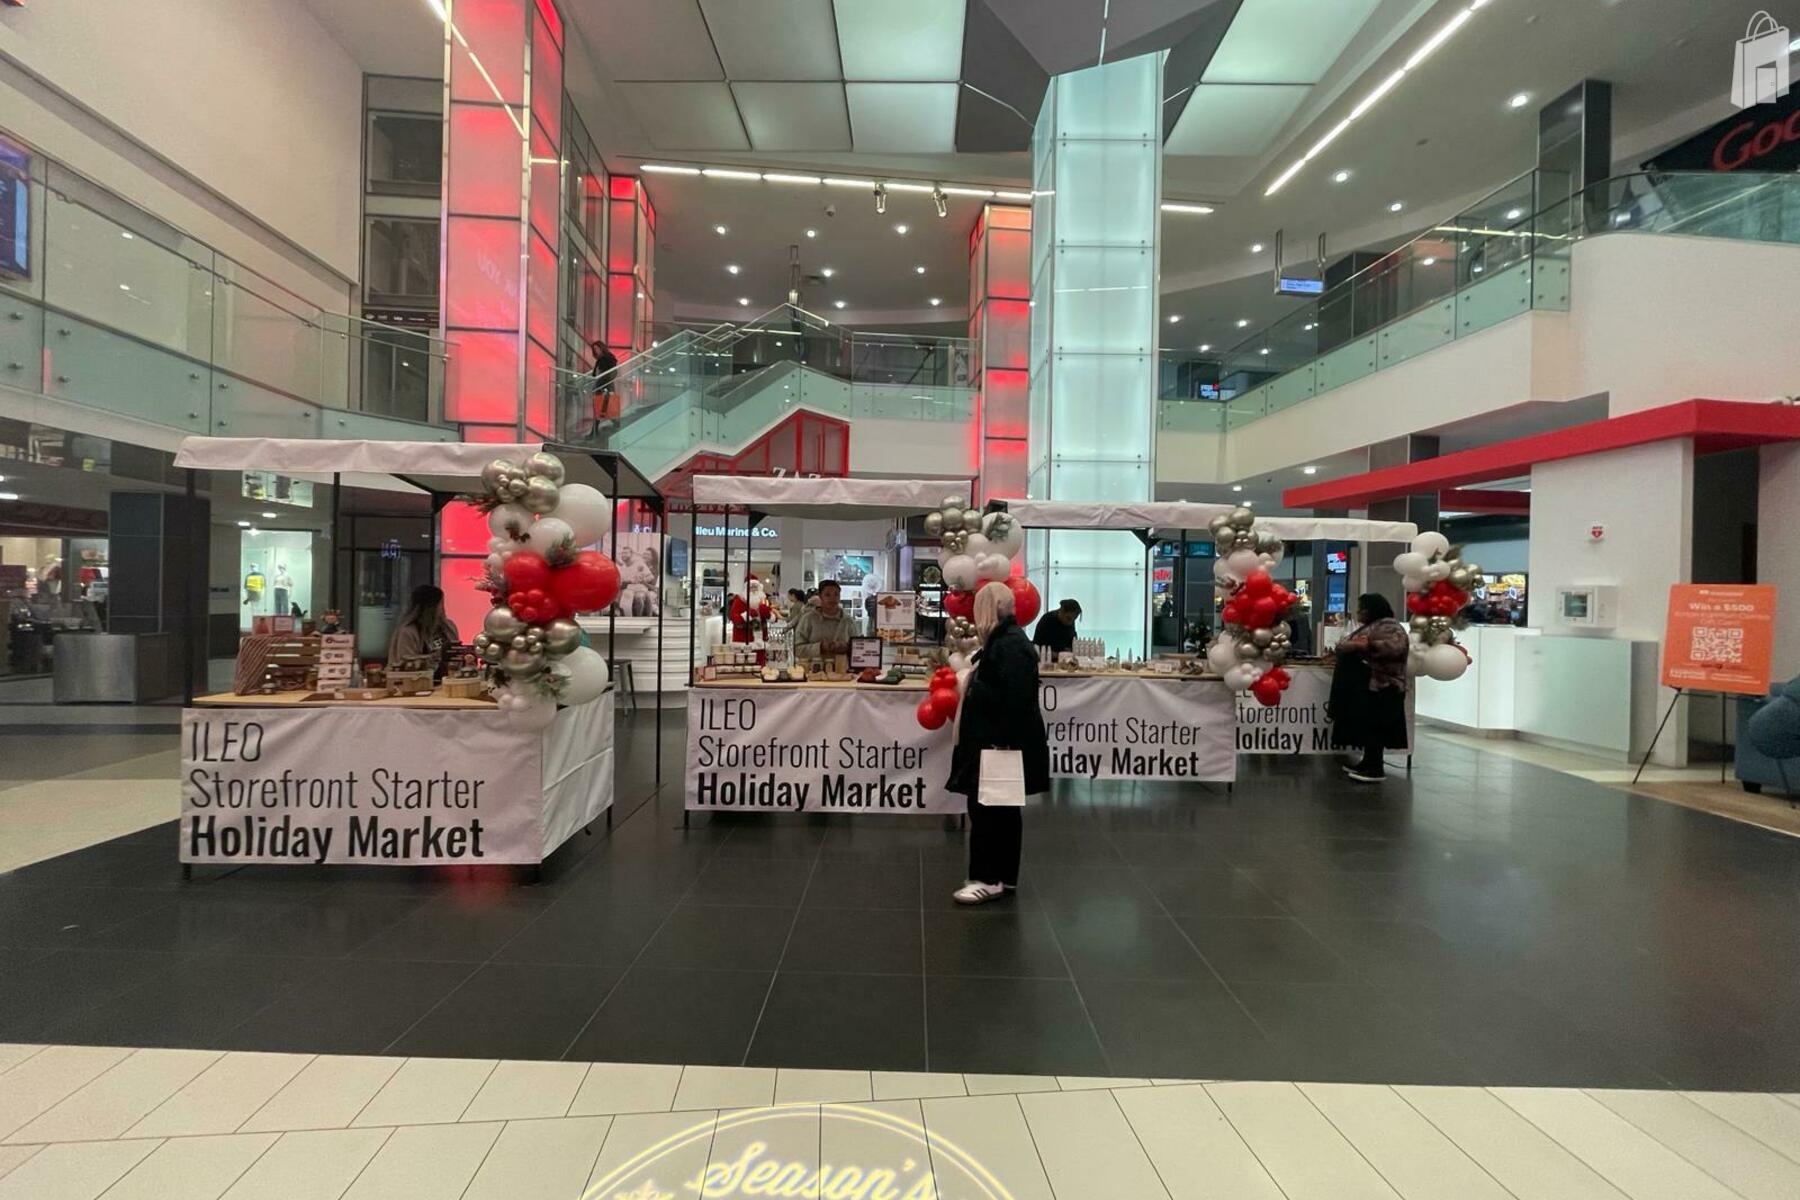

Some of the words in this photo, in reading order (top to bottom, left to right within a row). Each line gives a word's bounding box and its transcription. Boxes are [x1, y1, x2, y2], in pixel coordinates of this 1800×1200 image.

[752, 527, 760, 536] &
[761, 527, 778, 537] Co.
[700, 698, 757, 731] ILEO
[1235, 702, 1316, 724] torefront
[191, 721, 264, 762] ILEO
[1046, 716, 1118, 743] refront
[1125, 717, 1200, 745] Starter
[698, 735, 830, 769] Storefront
[838, 737, 927, 769] Starter
[1052, 746, 1102, 779] iday
[1111, 747, 1199, 777] Market
[189, 768, 358, 808] Storefront
[371, 768, 485, 809] Starter
[698, 772, 810, 811] Holiday
[821, 773, 927, 808] Market
[190, 815, 333, 863] Holiday
[348, 815, 484, 858] Market
